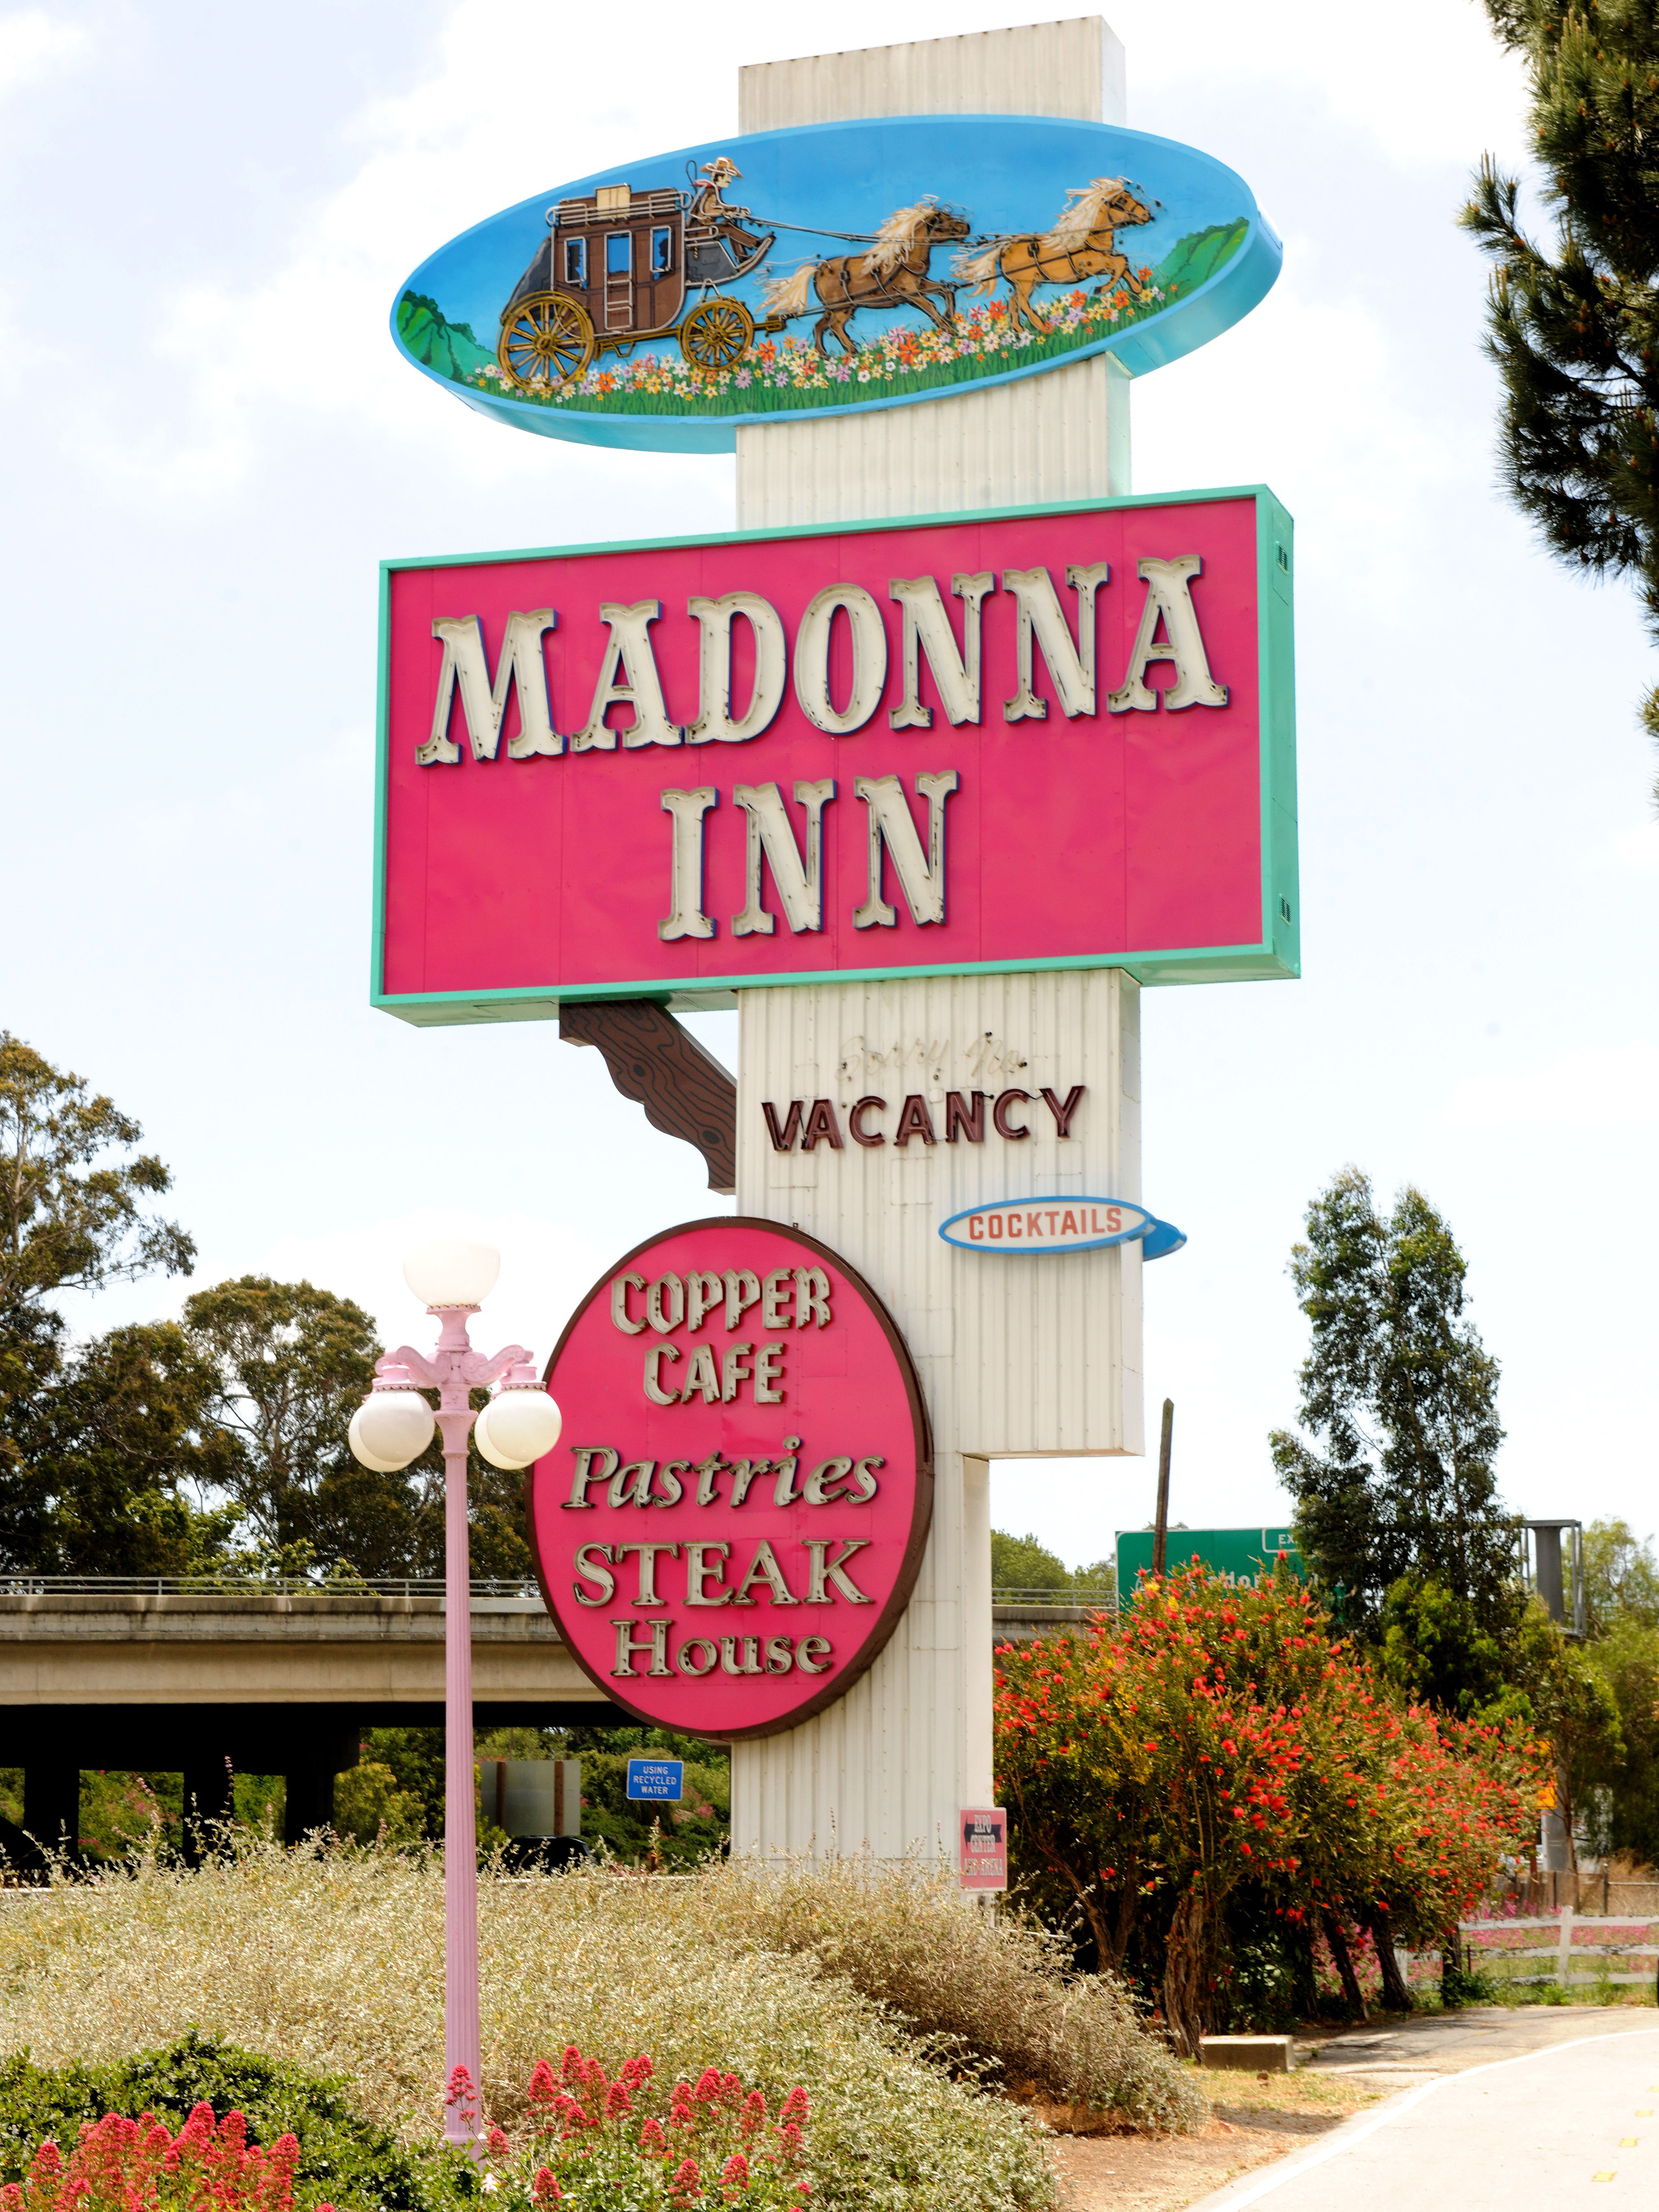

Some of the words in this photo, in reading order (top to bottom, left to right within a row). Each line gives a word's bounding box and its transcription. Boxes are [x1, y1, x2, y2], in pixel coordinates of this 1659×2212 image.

[415, 554, 1230, 766] MADONNA
[658, 770, 960, 941] INN
[761, 1085, 1086, 1151] VACANCY
[969, 1207, 1122, 1240] COCKTAILS
[611, 1265, 832, 1335] COPPER
[643, 1342, 785, 1406] CAFE
[560, 1435, 886, 1509] Pastries
[1278, 1534, 1294, 1544] EX
[572, 1539, 875, 1607] STEAK
[609, 1618, 833, 1677] House
[633, 1775, 677, 1785] RECYCLED
[641, 1786, 668, 1794] WATER
[643, 1766, 669, 1774] USING
[970, 1834, 996, 1853] CENTER
[974, 1814, 992, 1833] EXPO
[980, 1857, 1003, 1876] ARENA
